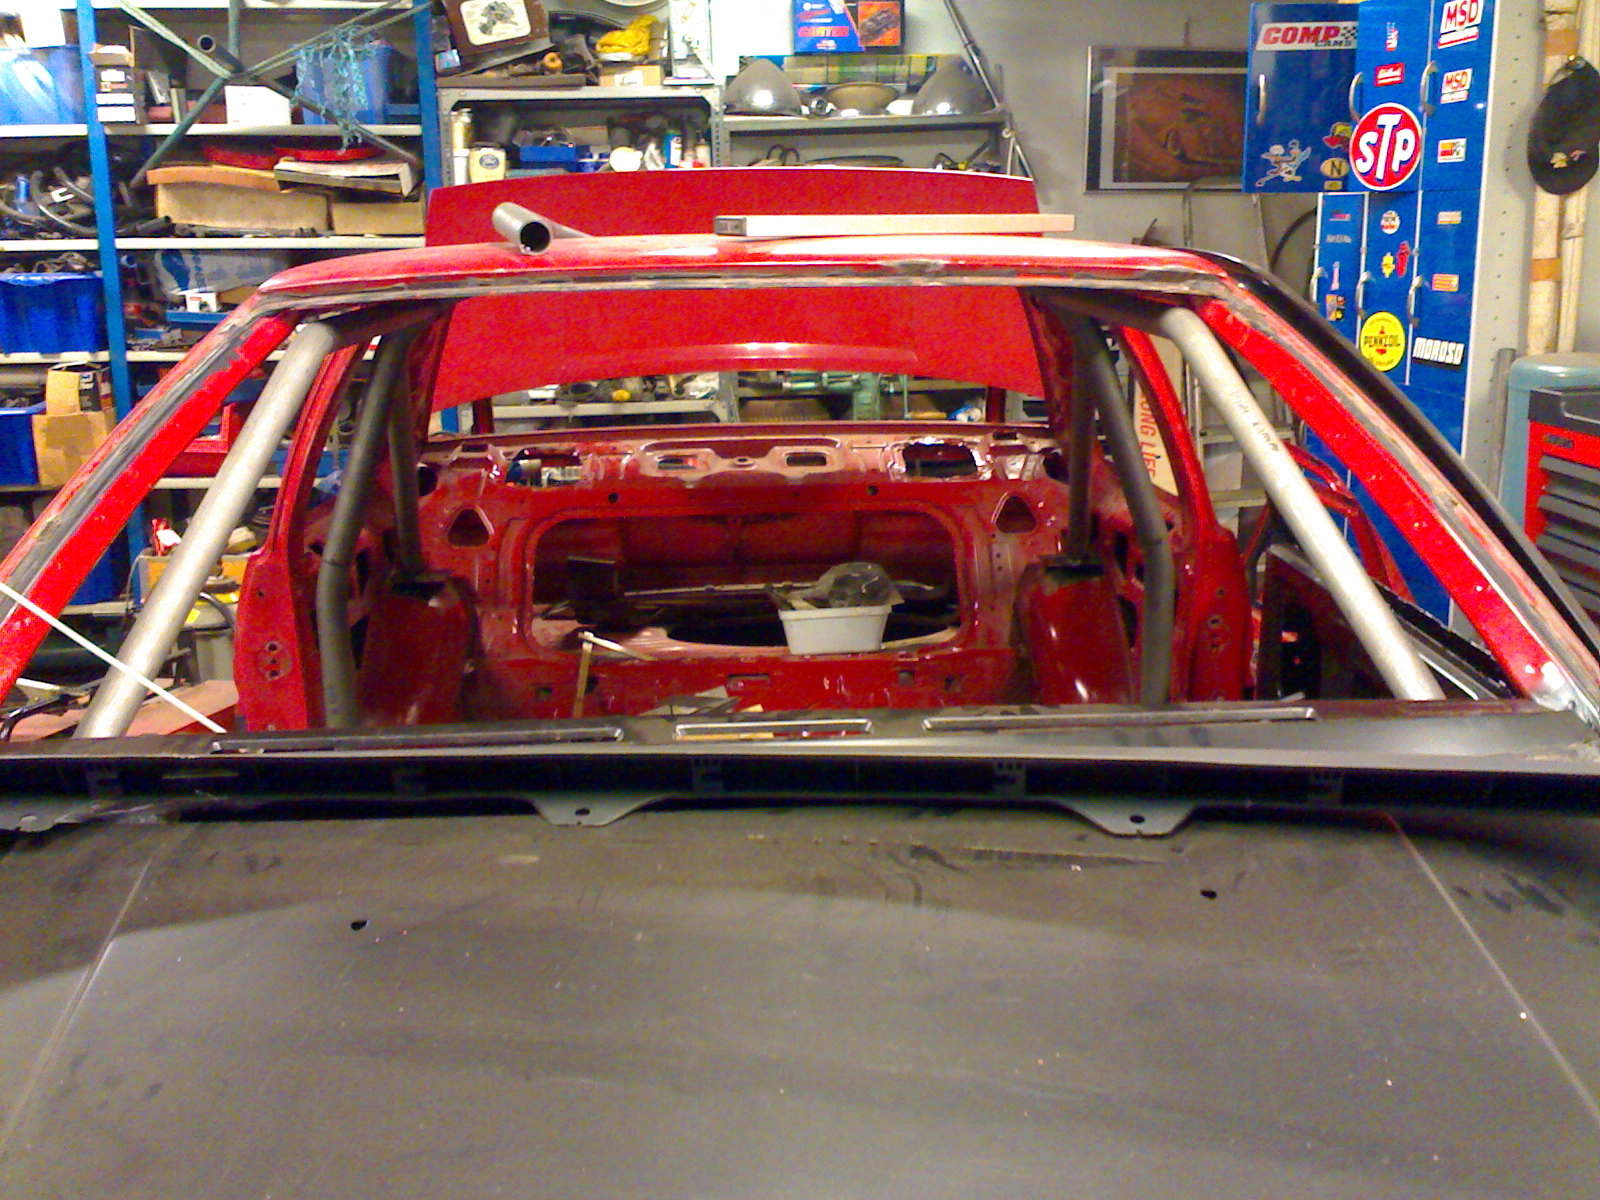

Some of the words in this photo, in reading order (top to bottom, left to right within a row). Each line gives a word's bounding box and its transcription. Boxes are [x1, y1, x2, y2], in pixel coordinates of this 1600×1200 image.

[1445, 0, 1479, 29] MSD
[1263, 26, 1341, 45] COMP
[1445, 71, 1468, 90] MSD
[1355, 113, 1416, 181] STP
[1412, 337, 1465, 365] MOROSO
